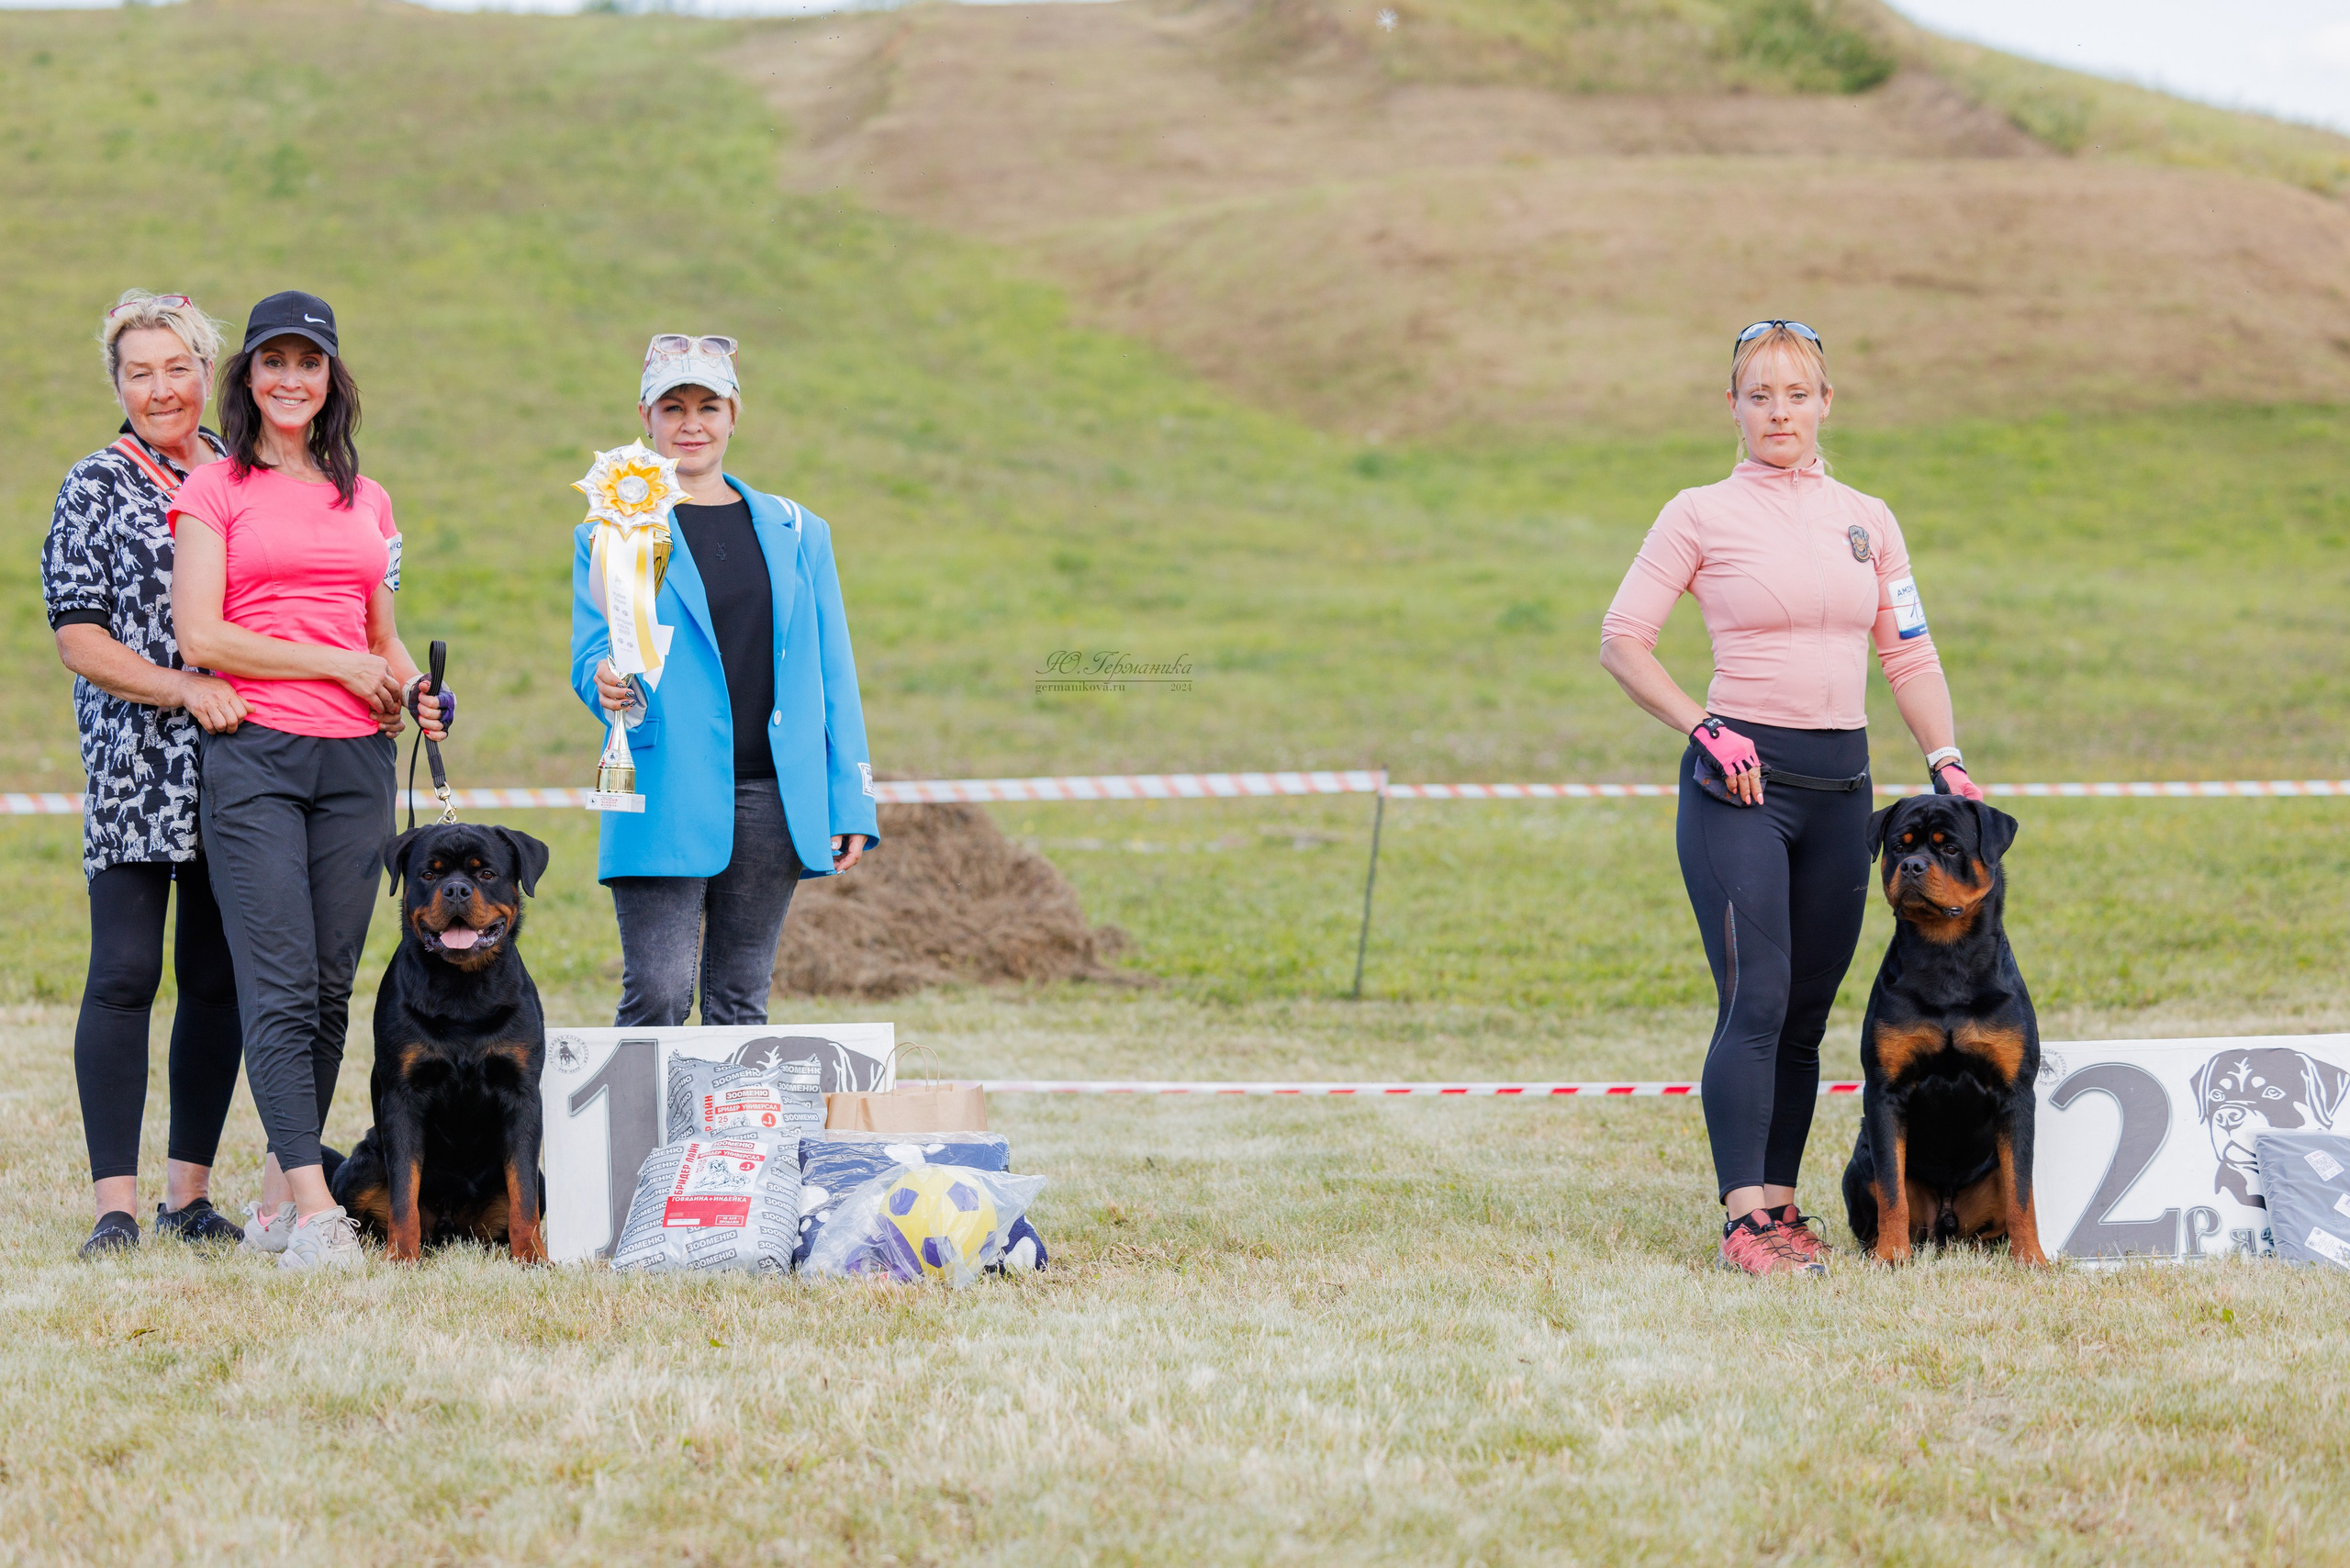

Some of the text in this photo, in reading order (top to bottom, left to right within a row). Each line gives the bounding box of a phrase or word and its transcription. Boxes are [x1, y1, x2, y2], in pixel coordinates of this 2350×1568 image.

[778, 1082, 819, 1092] ЗООМЕНЮ
[726, 1090, 768, 1099] ЗООМЕНЮ
[703, 1095, 713, 1122] ЛАЙН
[717, 1104, 740, 1113] БРИДЕР
[784, 1114, 819, 1122] ЗООМЕНЮ
[568, 1038, 661, 1260] 1
[646, 1147, 683, 1161] ОМЕНЮ
[723, 1150, 760, 1160] УНИВЕРСАЛ
[2048, 1062, 2180, 1260] 2
[674, 1164, 691, 1195] БРИДЕР
[686, 1143, 699, 1163] ЛАЙН
[687, 1231, 736, 1251] ЗООМЕНЮ
